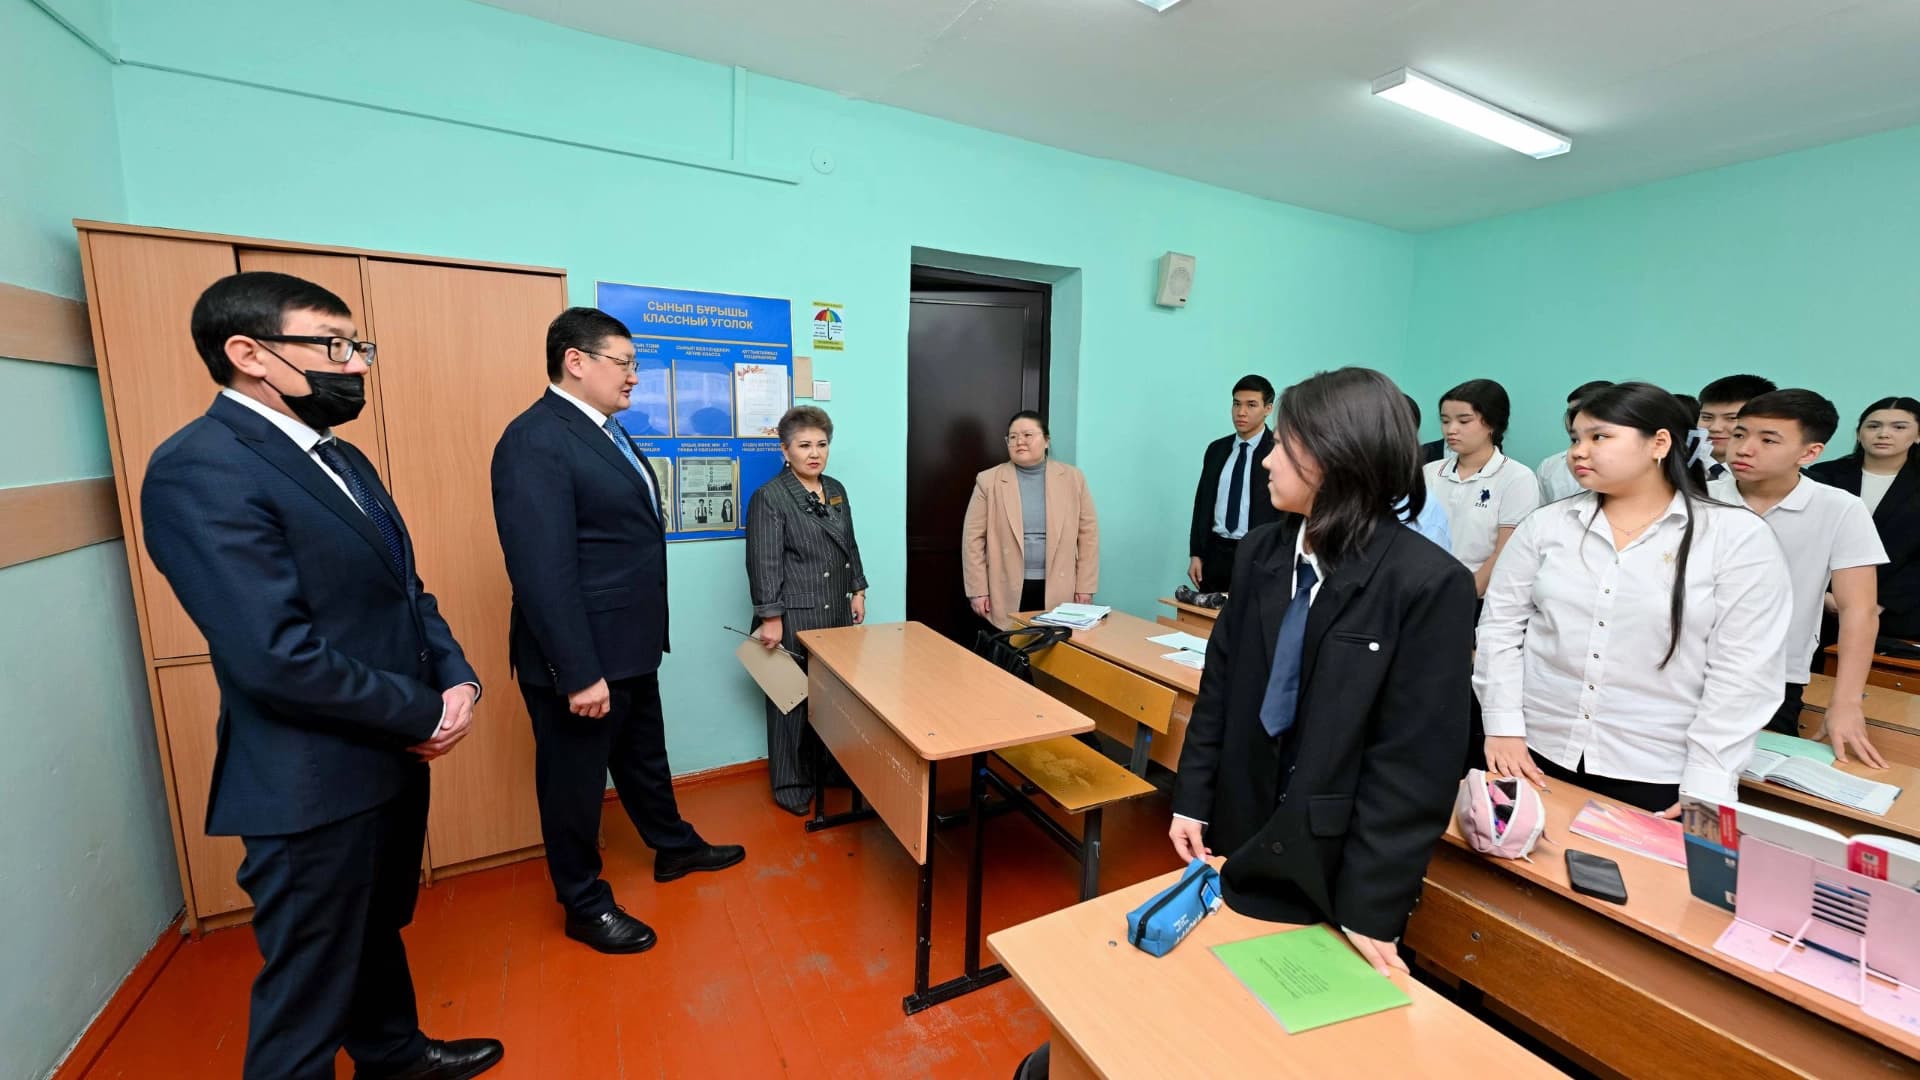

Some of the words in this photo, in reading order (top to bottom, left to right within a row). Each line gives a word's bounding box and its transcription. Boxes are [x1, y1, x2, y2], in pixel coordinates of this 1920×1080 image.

[647, 301, 694, 314] СЫНЫП
[696, 305, 749, 318] БҰРЫШЫ
[643, 313, 708, 327] КЛАССНЫЙ
[711, 318, 753, 330] УГОЛОК
